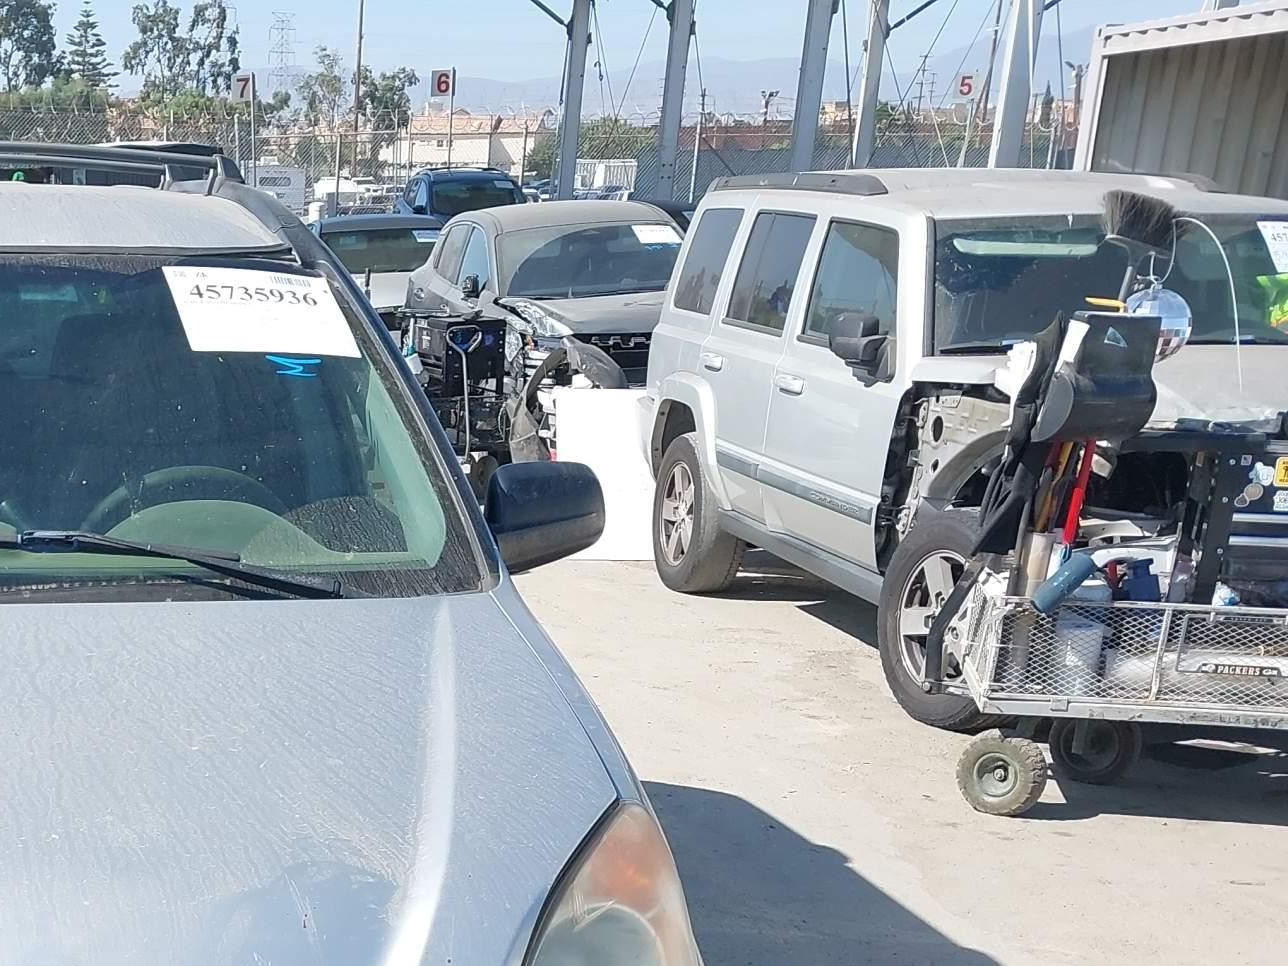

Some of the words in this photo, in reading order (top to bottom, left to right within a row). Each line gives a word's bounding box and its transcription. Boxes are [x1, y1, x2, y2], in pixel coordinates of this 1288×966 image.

[236, 77, 250, 98] 7
[437, 73, 450, 93] 6
[960, 76, 973, 95] 5
[189, 284, 317, 306] 45735936
[1216, 665, 1261, 676] PACKERS
